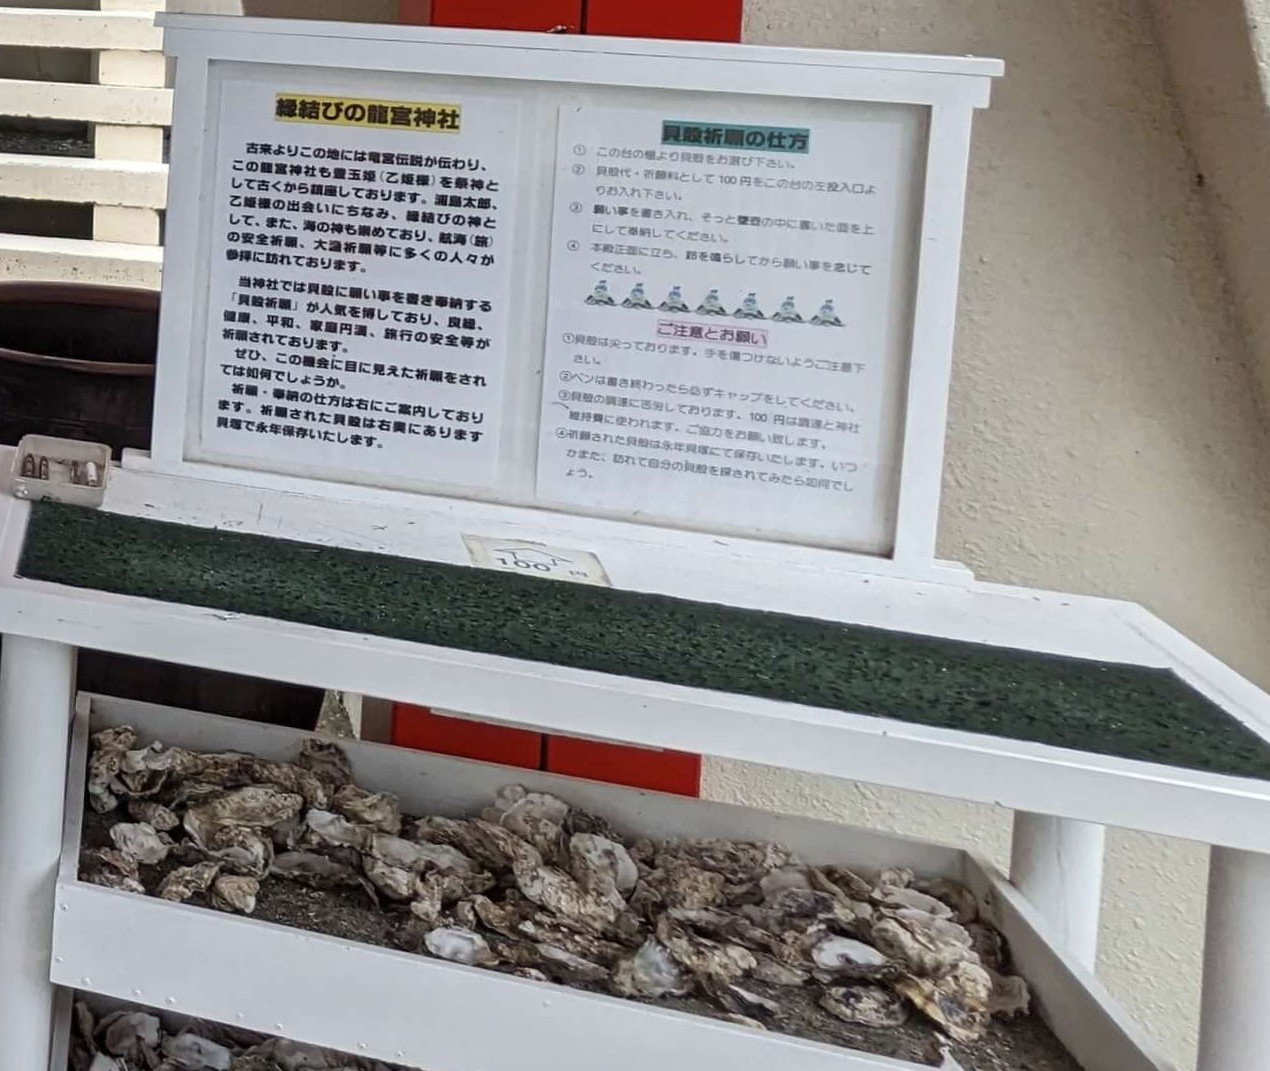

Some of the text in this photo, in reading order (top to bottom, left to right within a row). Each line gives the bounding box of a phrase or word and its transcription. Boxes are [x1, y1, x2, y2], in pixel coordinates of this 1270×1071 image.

[275, 97, 460, 130] 縁結びの龍宮神社
[658, 322, 767, 345] ご注意とお願い
